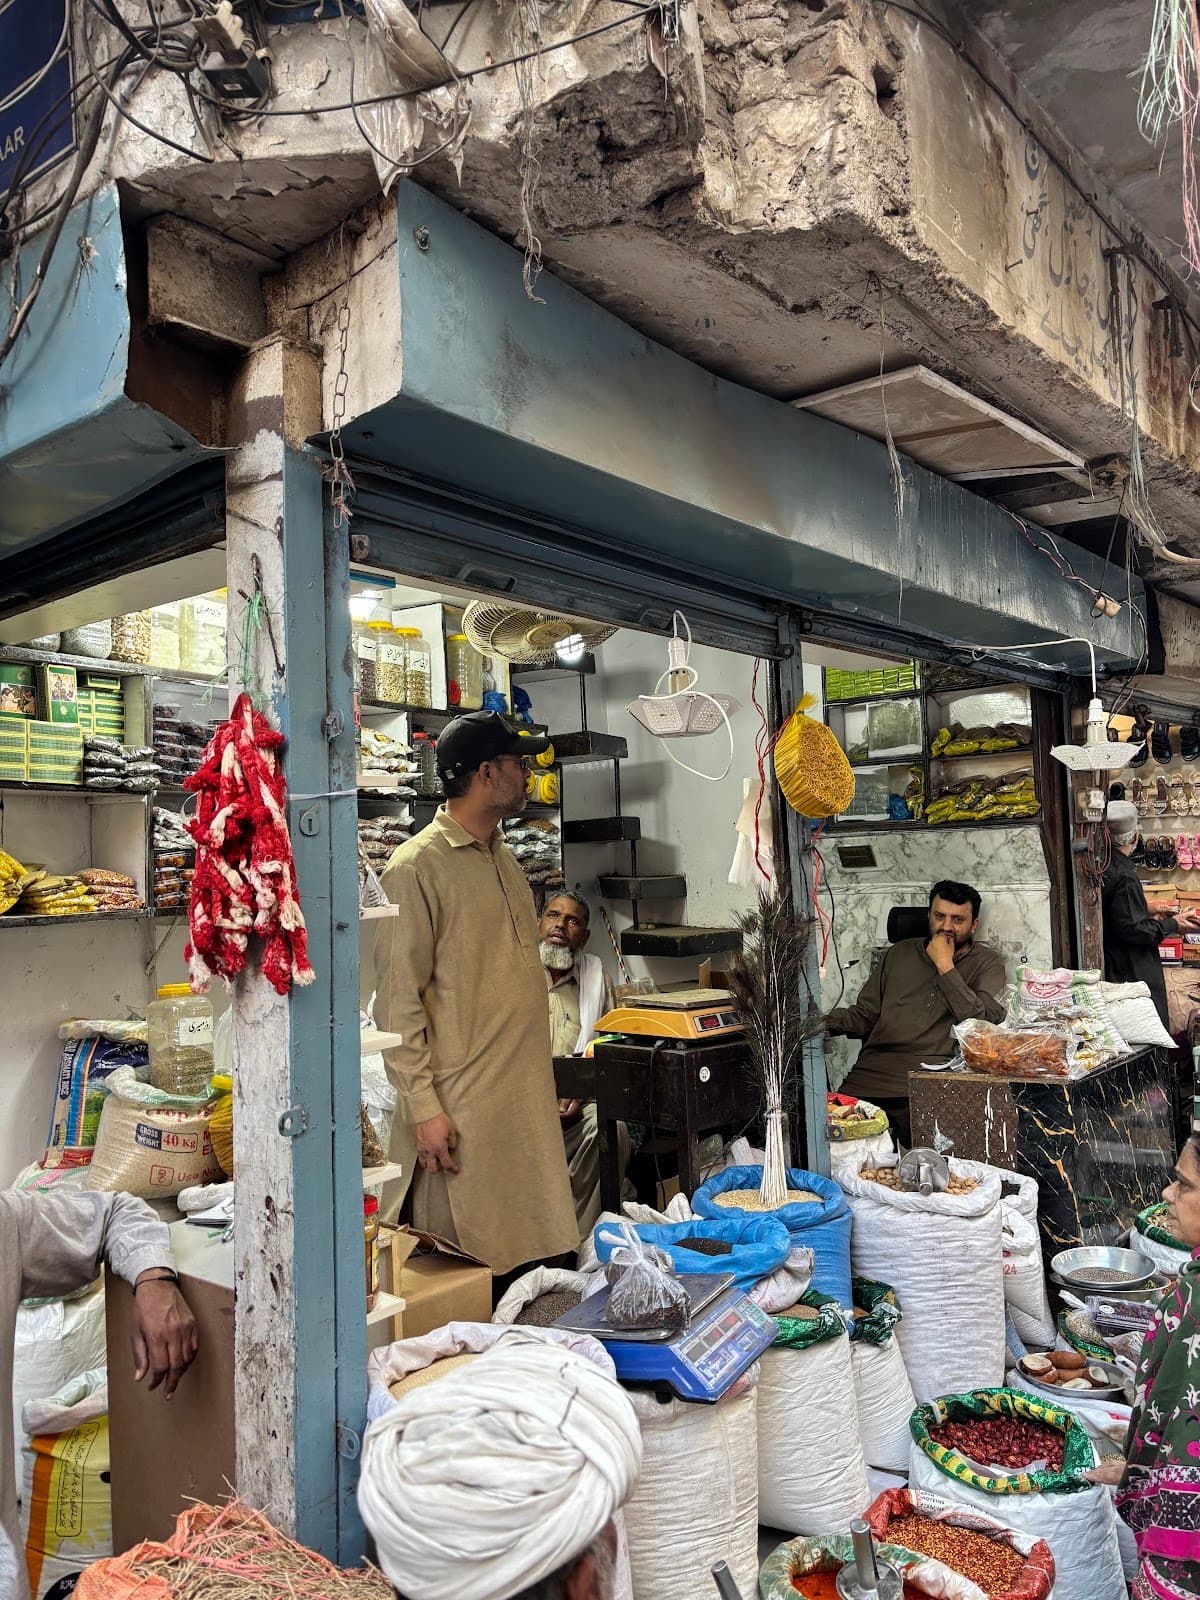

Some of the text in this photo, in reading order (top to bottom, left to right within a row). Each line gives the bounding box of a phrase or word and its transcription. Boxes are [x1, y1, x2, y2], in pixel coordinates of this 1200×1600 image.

[137, 1135, 160, 1150] WEIGHT
[163, 1134, 179, 1147] 40
[177, 1172, 199, 1182] Use
